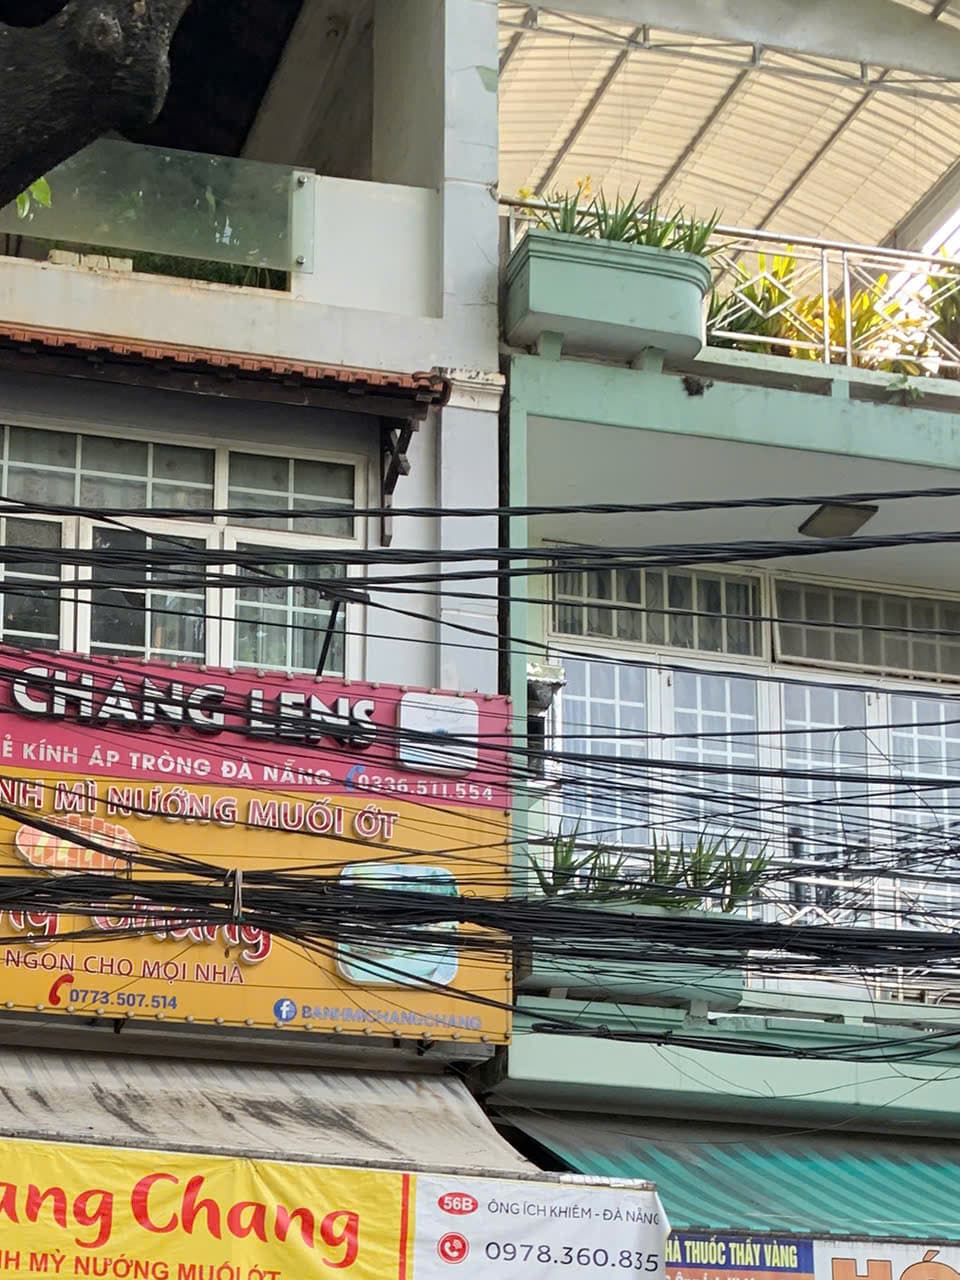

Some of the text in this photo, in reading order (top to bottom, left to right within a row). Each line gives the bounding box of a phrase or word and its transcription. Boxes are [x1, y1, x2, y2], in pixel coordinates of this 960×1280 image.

[11, 666, 226, 732] CHANG
[249, 689, 377, 744] LENS
[22, 739, 78, 764] KÍNH
[88, 745, 121, 767] ÁP
[129, 750, 211, 776] TRÒNG
[221, 757, 254, 780] ĐÀ
[357, 774, 494, 800] 0336.511.554
[55, 778, 98, 813] MÌ
[107, 785, 238, 827] NƯỚNG
[248, 797, 344, 835] MUỐI
[354, 804, 401, 840] ỚT
[5, 949, 75, 972] NGON
[83, 955, 133, 977] CHO
[142, 959, 187, 984] MỌI
[195, 961, 244, 984] NHÀ
[69, 989, 177, 1009] 0773.507.514
[130, 1172, 360, 1269] Chang
[443, 1196, 474, 1212] 56B
[487, 1199, 519, 1215] ÔNG
[523, 1201, 546, 1217] ÍCH
[550, 1204, 591, 1219] KHIÊM
[603, 1208, 623, 1221] ĐÀ
[74, 1254, 169, 1280] NƯỚNG
[485, 1242, 658, 1272] 0978.360.835
[665, 1236, 681, 1262] HÀ
[684, 1234, 726, 1265] THUỐC
[763, 1240, 798, 1268] VÀNG
